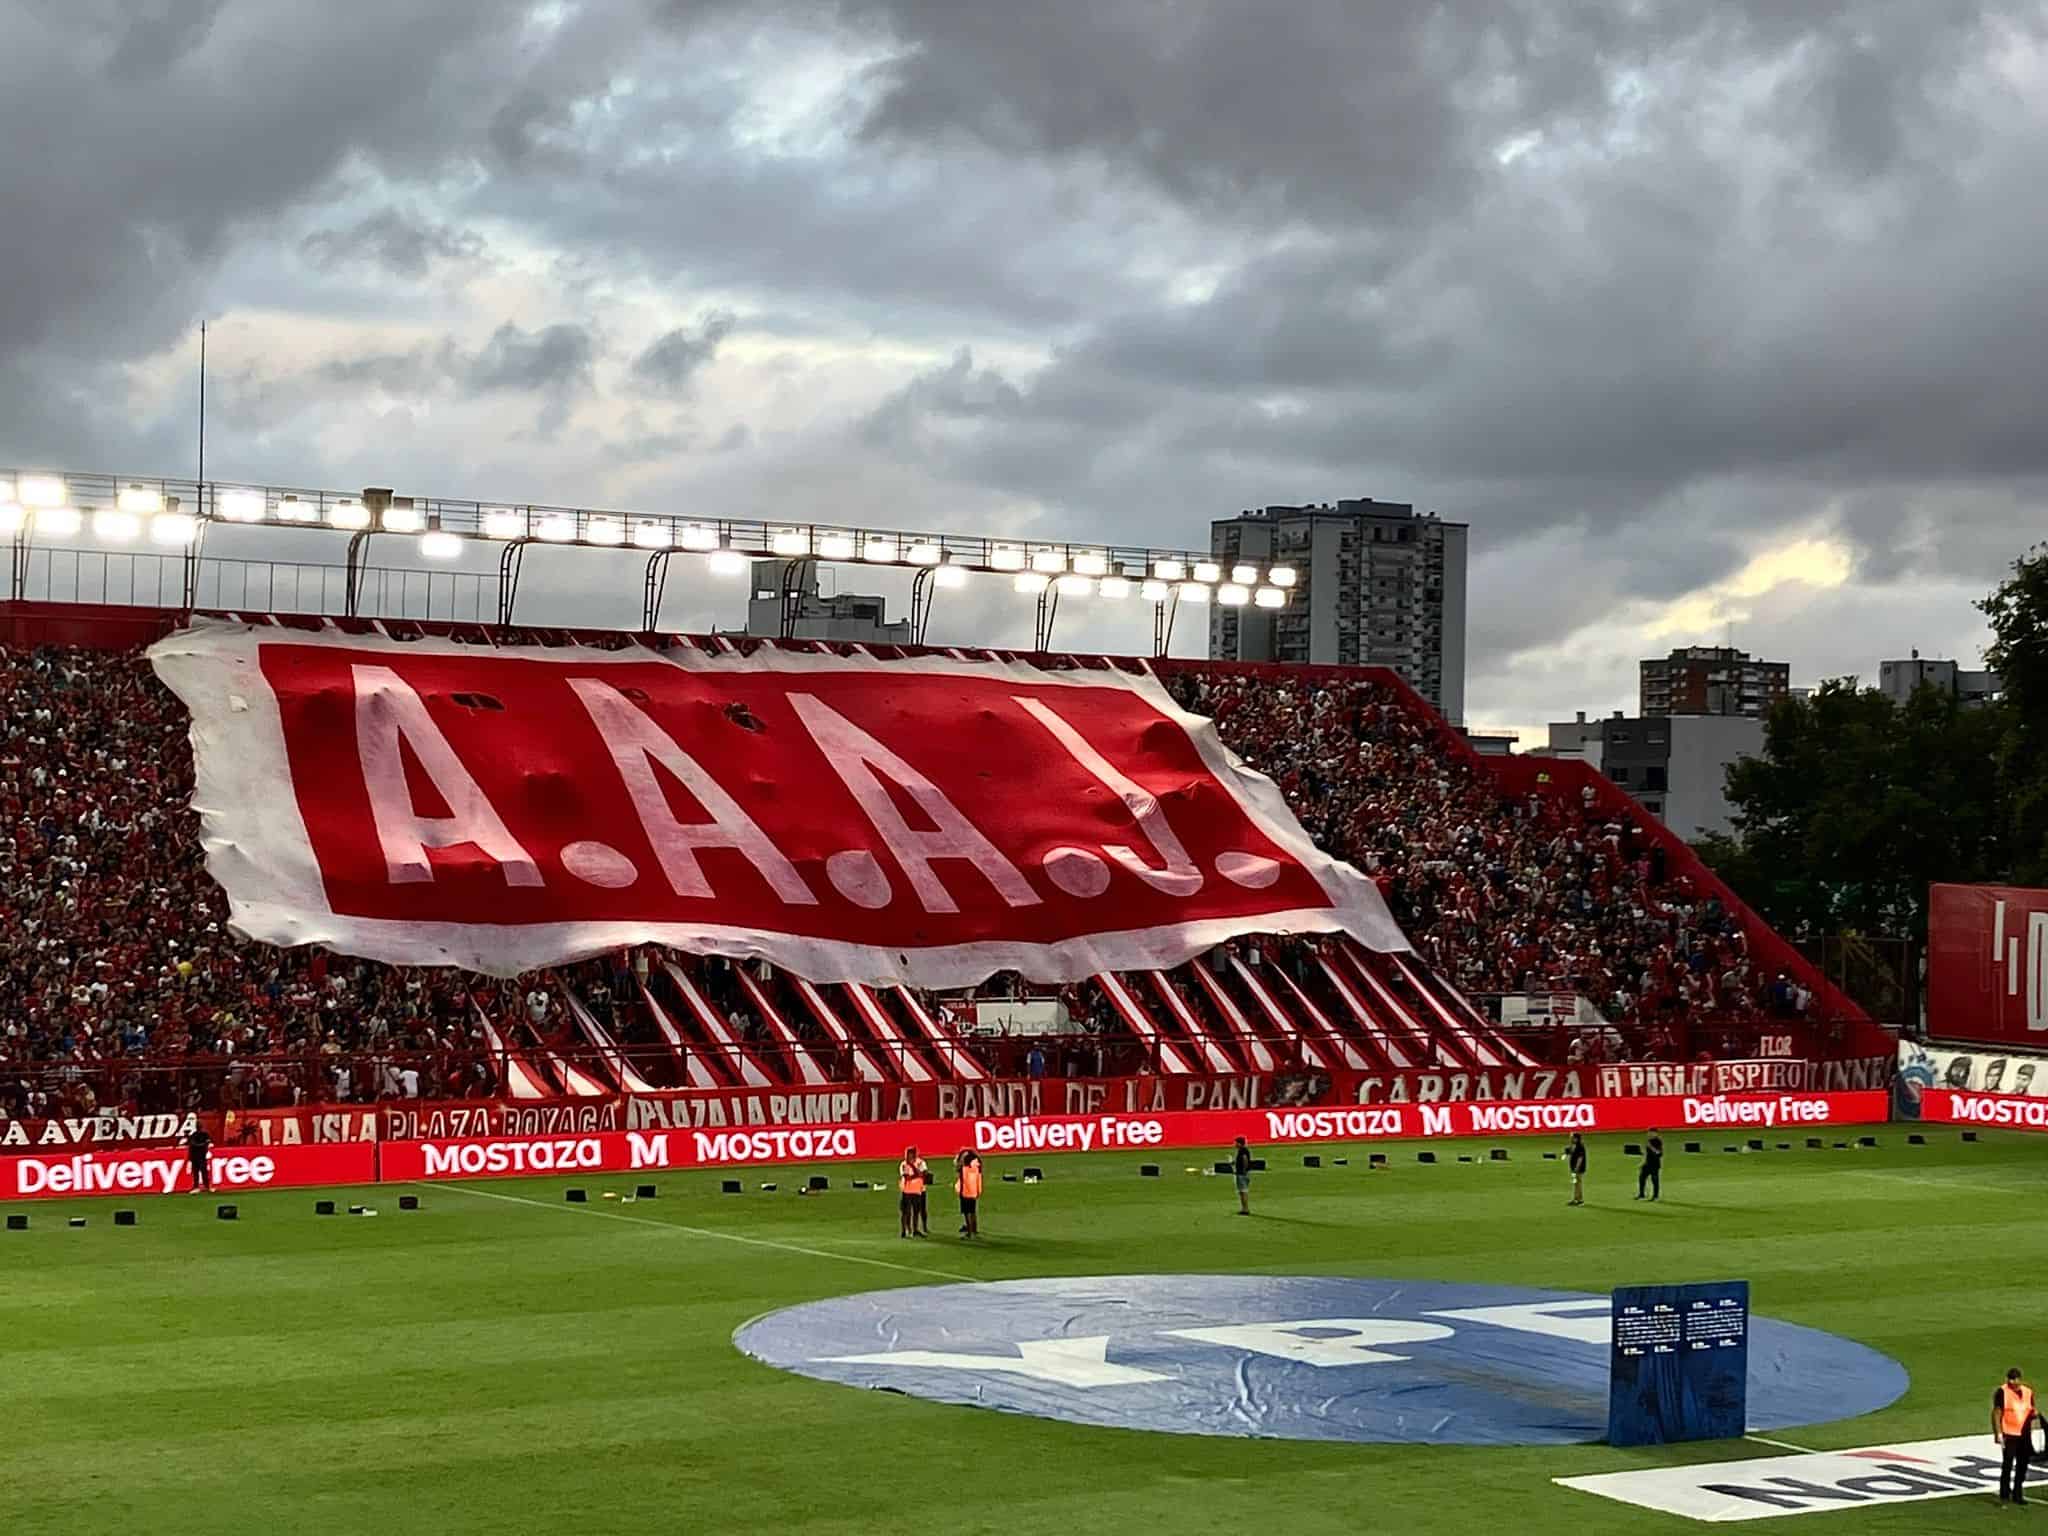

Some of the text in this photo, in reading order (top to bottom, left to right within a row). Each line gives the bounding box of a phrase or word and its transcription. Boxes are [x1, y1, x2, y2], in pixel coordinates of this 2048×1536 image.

[1761, 1036, 1792, 1056] FLOR
[1357, 1070, 1582, 1105] CARRANZA
[1718, 1063, 1801, 1092] ESPIRO
[1419, 1105, 1453, 1135] M
[1683, 1095, 1829, 1127] Delivery Free
[38, 1112, 197, 1144] AVENIDA
[260, 1113, 377, 1145] LA ISLA
[974, 1117, 1163, 1151] Delivery Free
[626, 1132, 669, 1168] M
[17, 1153, 184, 1194] Delivery
